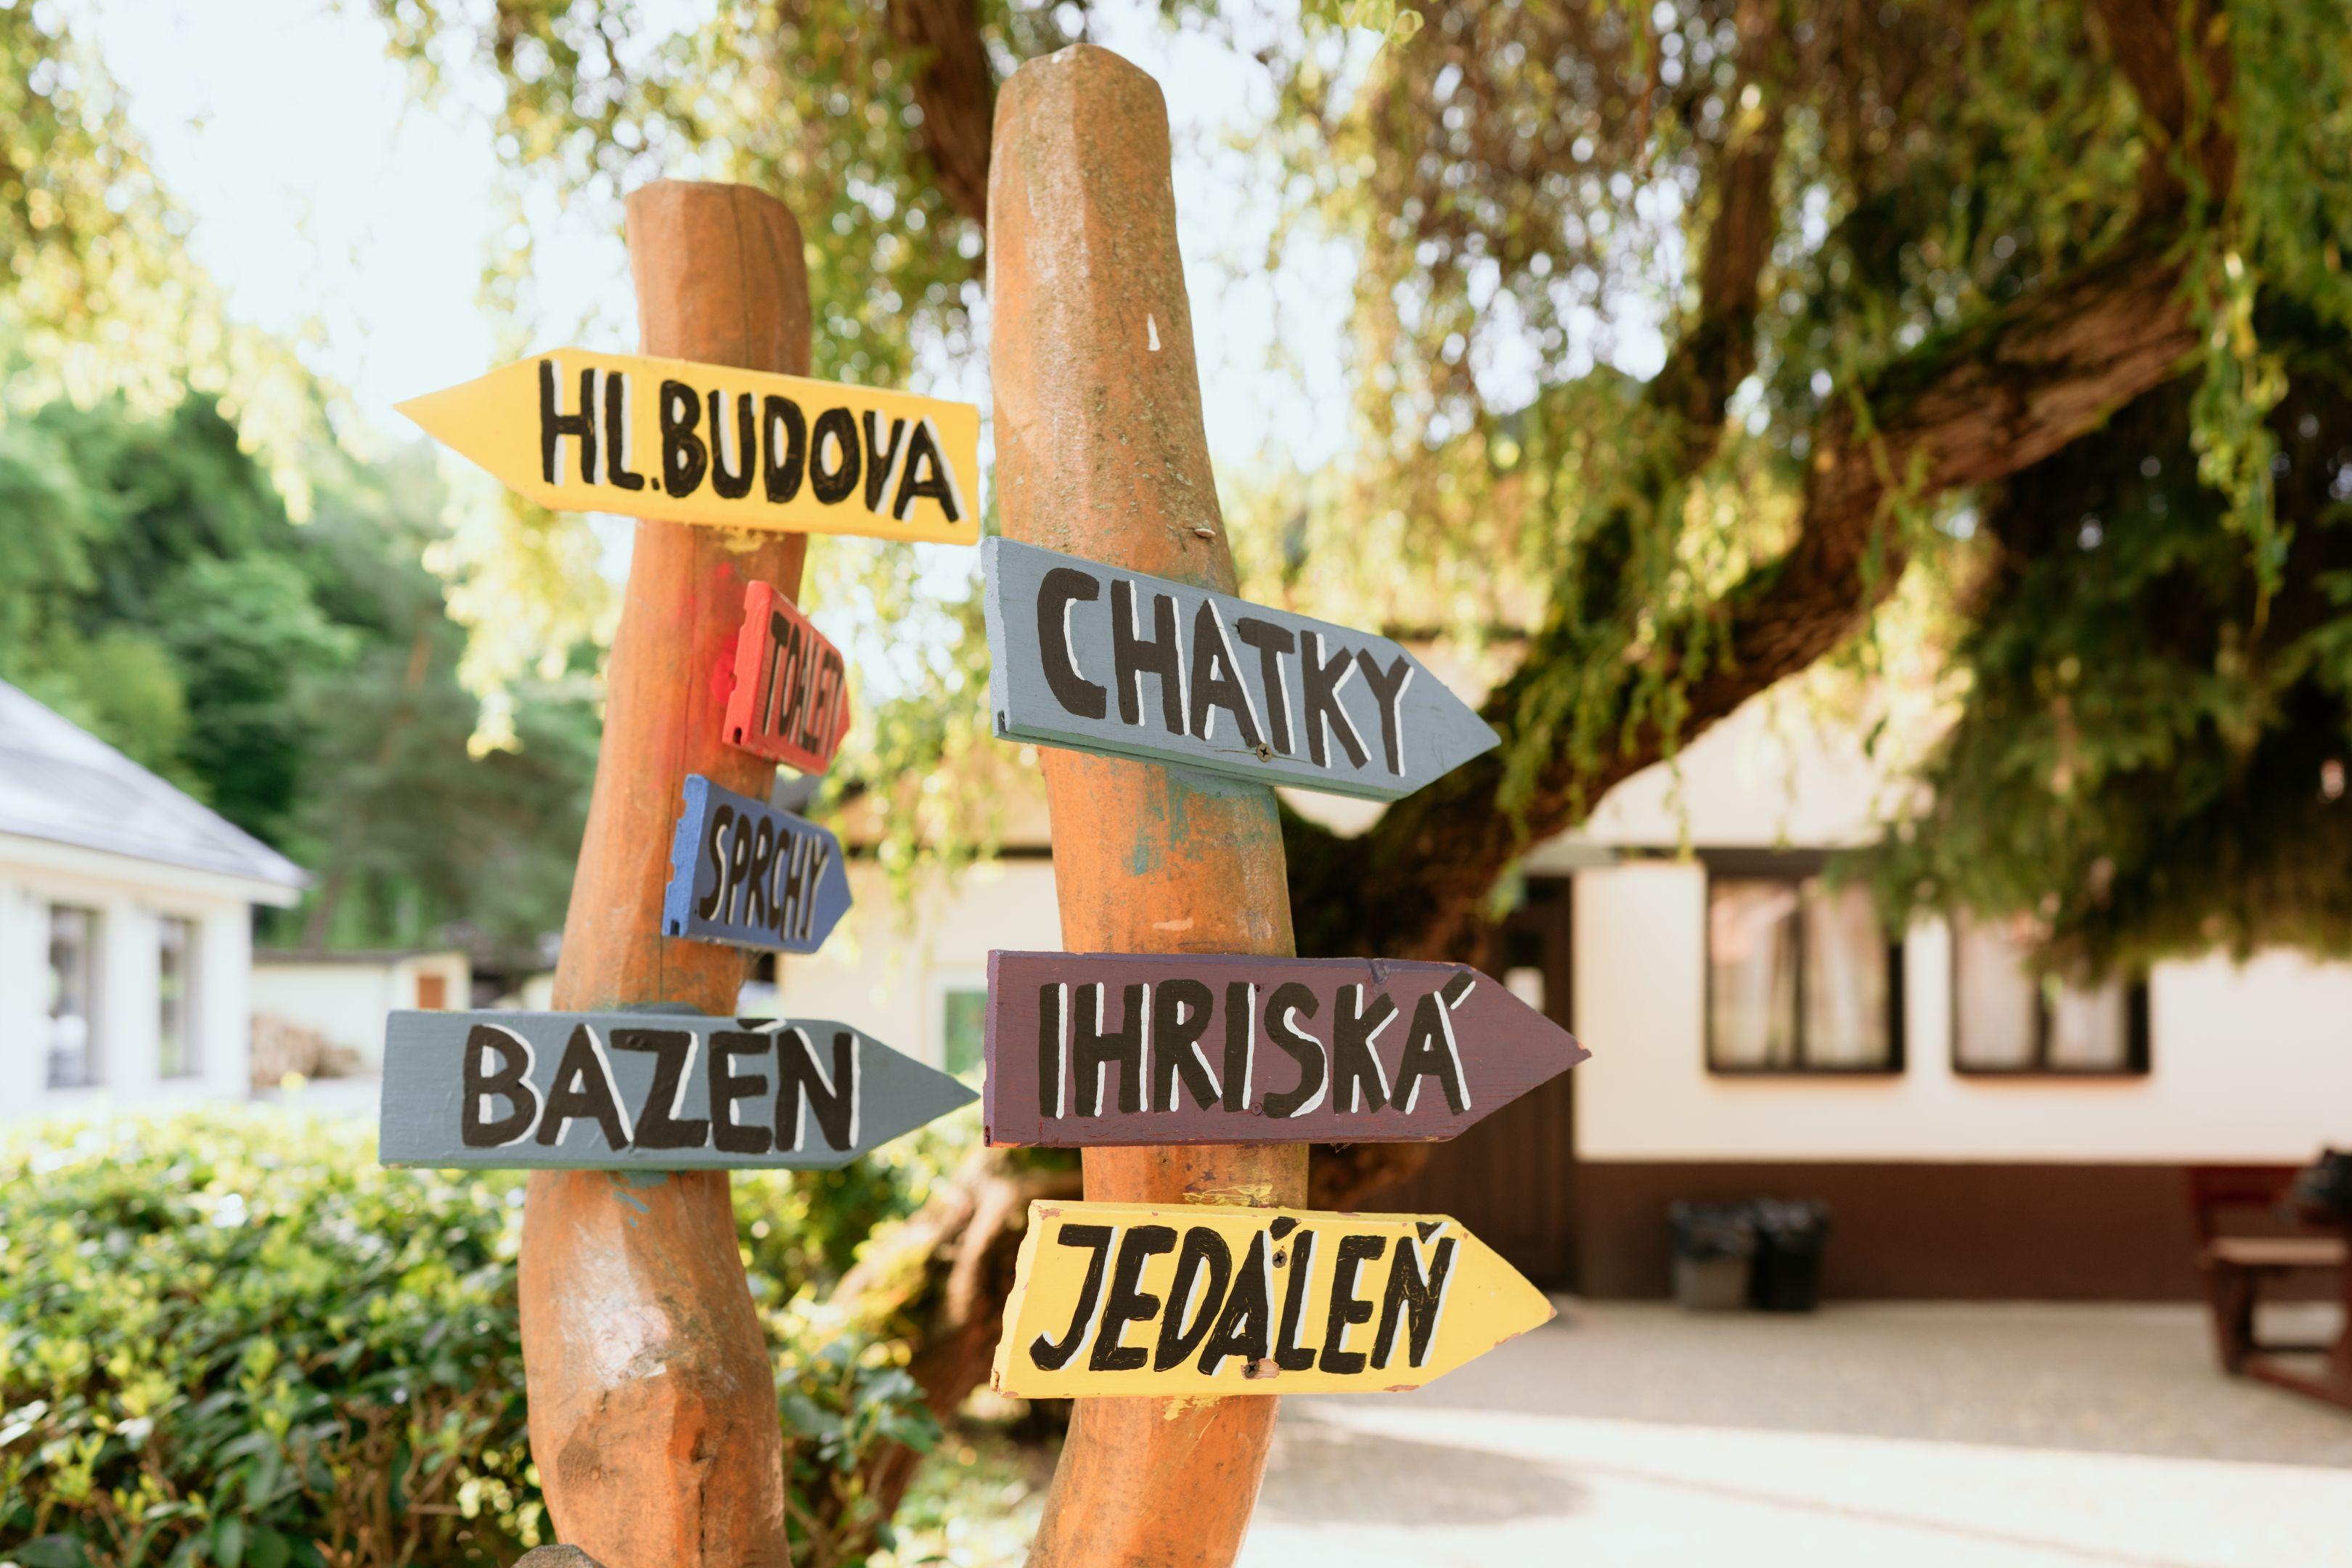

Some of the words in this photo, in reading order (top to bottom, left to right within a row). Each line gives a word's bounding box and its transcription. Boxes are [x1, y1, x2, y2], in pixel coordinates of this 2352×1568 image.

[539, 359, 968, 523] HL.BUDOVA
[1037, 567, 1415, 777] CHATKY
[698, 804, 830, 942] SPRCHY
[462, 1018, 861, 1153] BAZÉN
[1039, 970, 1476, 1119] IHRISKÁ
[1029, 1216, 1461, 1377] JEDÁLEŇ
